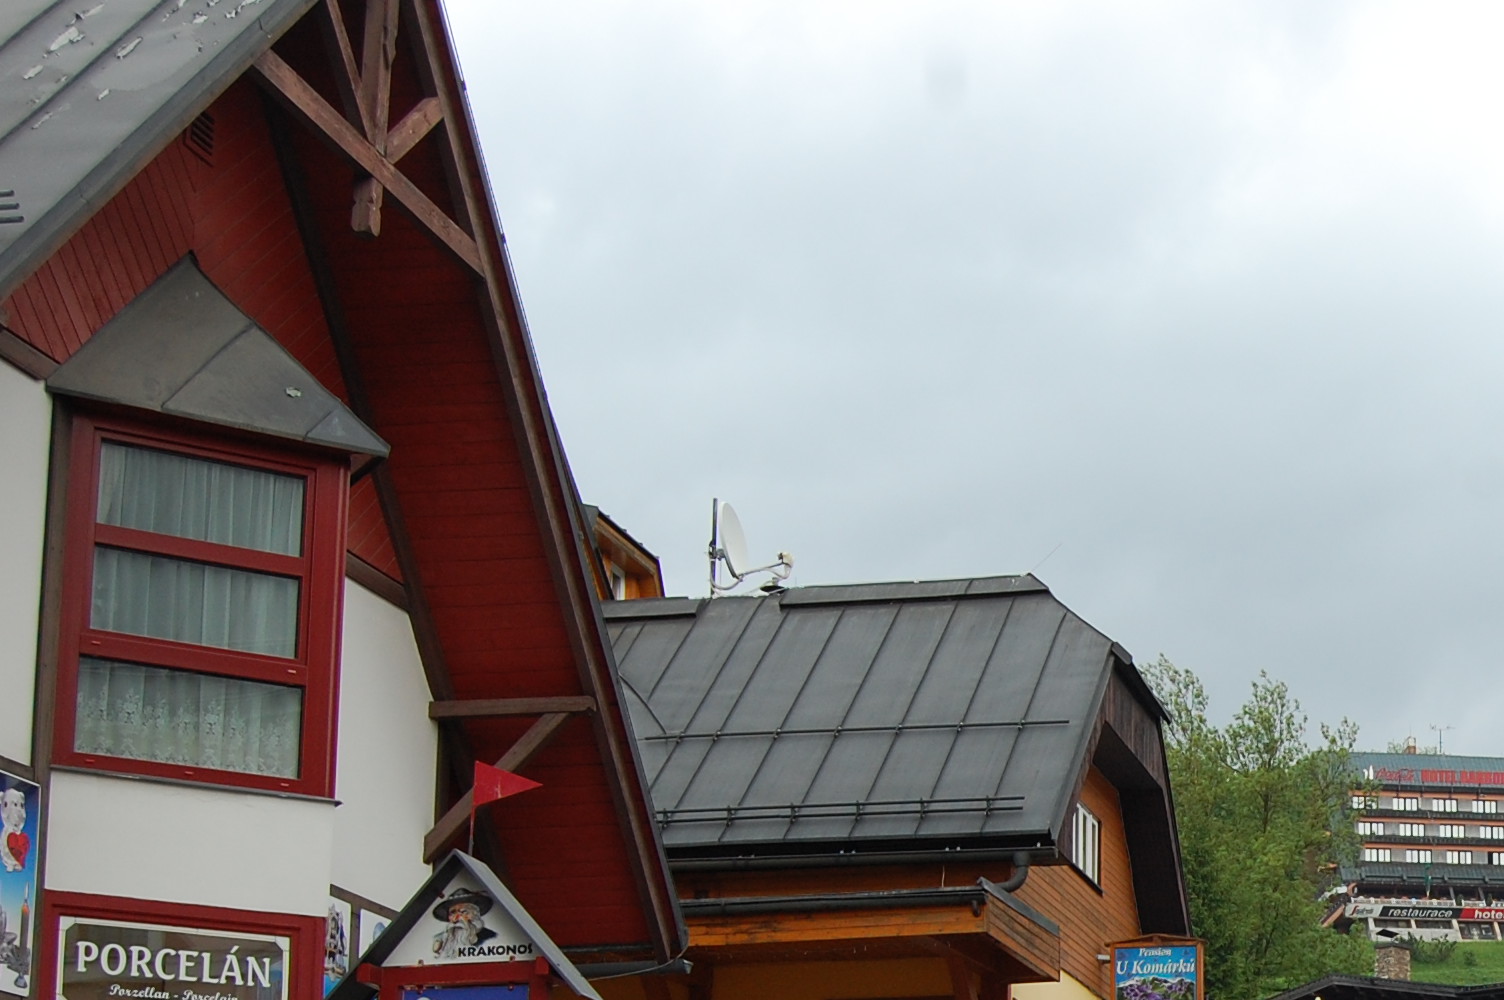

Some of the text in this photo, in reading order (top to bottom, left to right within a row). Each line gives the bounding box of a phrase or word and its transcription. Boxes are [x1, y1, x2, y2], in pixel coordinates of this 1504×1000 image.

[1388, 907, 1453, 918] restaurace
[76, 940, 272, 988] PORCELÁN
[1117, 960, 1128, 975] U
[109, 984, 170, 1000] Porzellan
